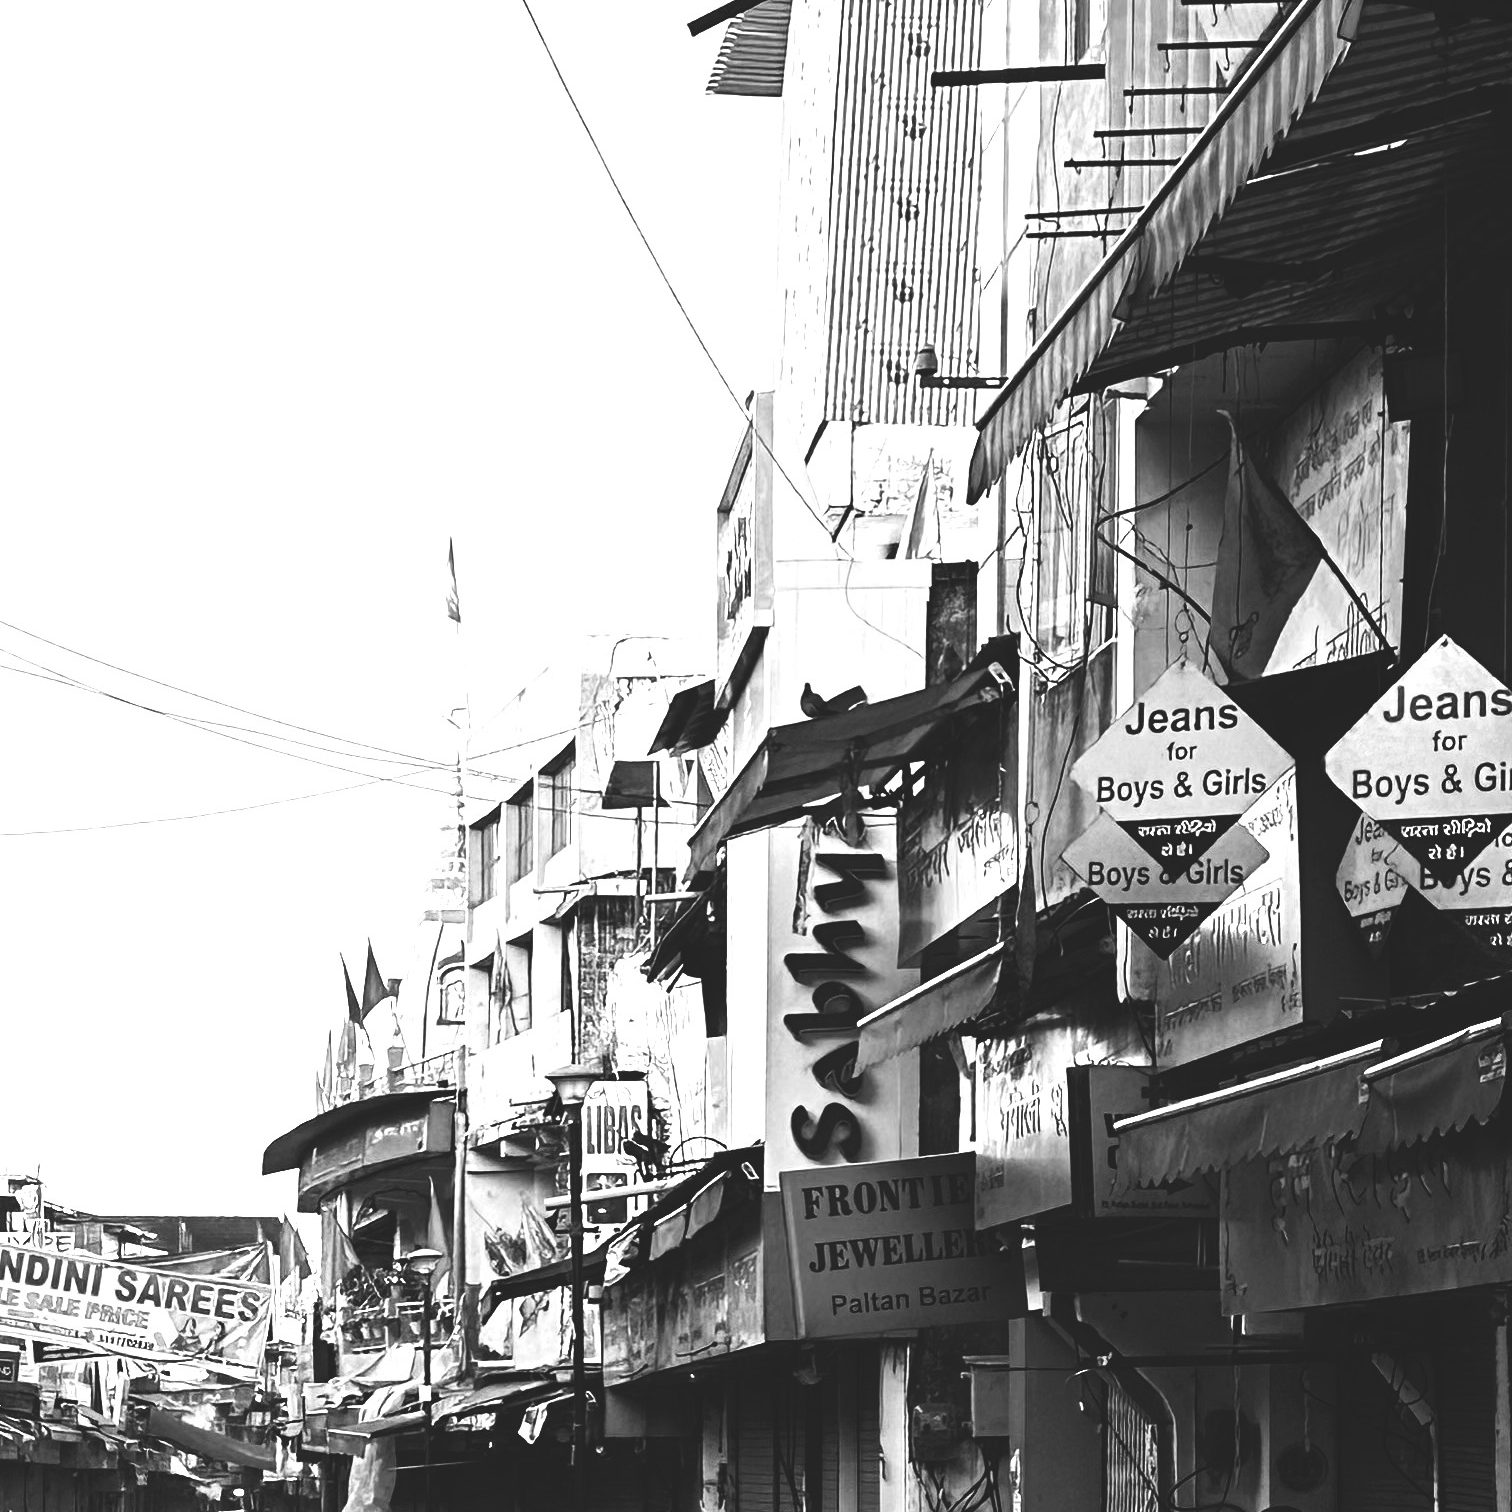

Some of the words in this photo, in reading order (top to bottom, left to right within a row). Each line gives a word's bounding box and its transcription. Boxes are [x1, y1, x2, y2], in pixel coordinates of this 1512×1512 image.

[1125, 702, 1238, 735] Jeans
[1383, 685, 1512, 722] Jeans
[1166, 742, 1197, 761] for
[1432, 730, 1467, 752] for
[1096, 775, 1164, 808] Boys
[1173, 771, 1193, 798] &
[1202, 767, 1267, 797] Girls
[1352, 769, 1430, 804] Boys
[1441, 764, 1463, 795] &
[1088, 861, 1150, 892] Boys
[1188, 858, 1244, 885] Girls
[586, 1104, 642, 1155] LIBAS
[801, 1172, 973, 1220] FRONTIE
[24, 1291, 82, 1317] SALE
[85, 1301, 150, 1329] PRICE
[115, 1269, 261, 1322] SAREES
[831, 1292, 910, 1316] Paltan
[918, 1286, 993, 1307] Bazar
